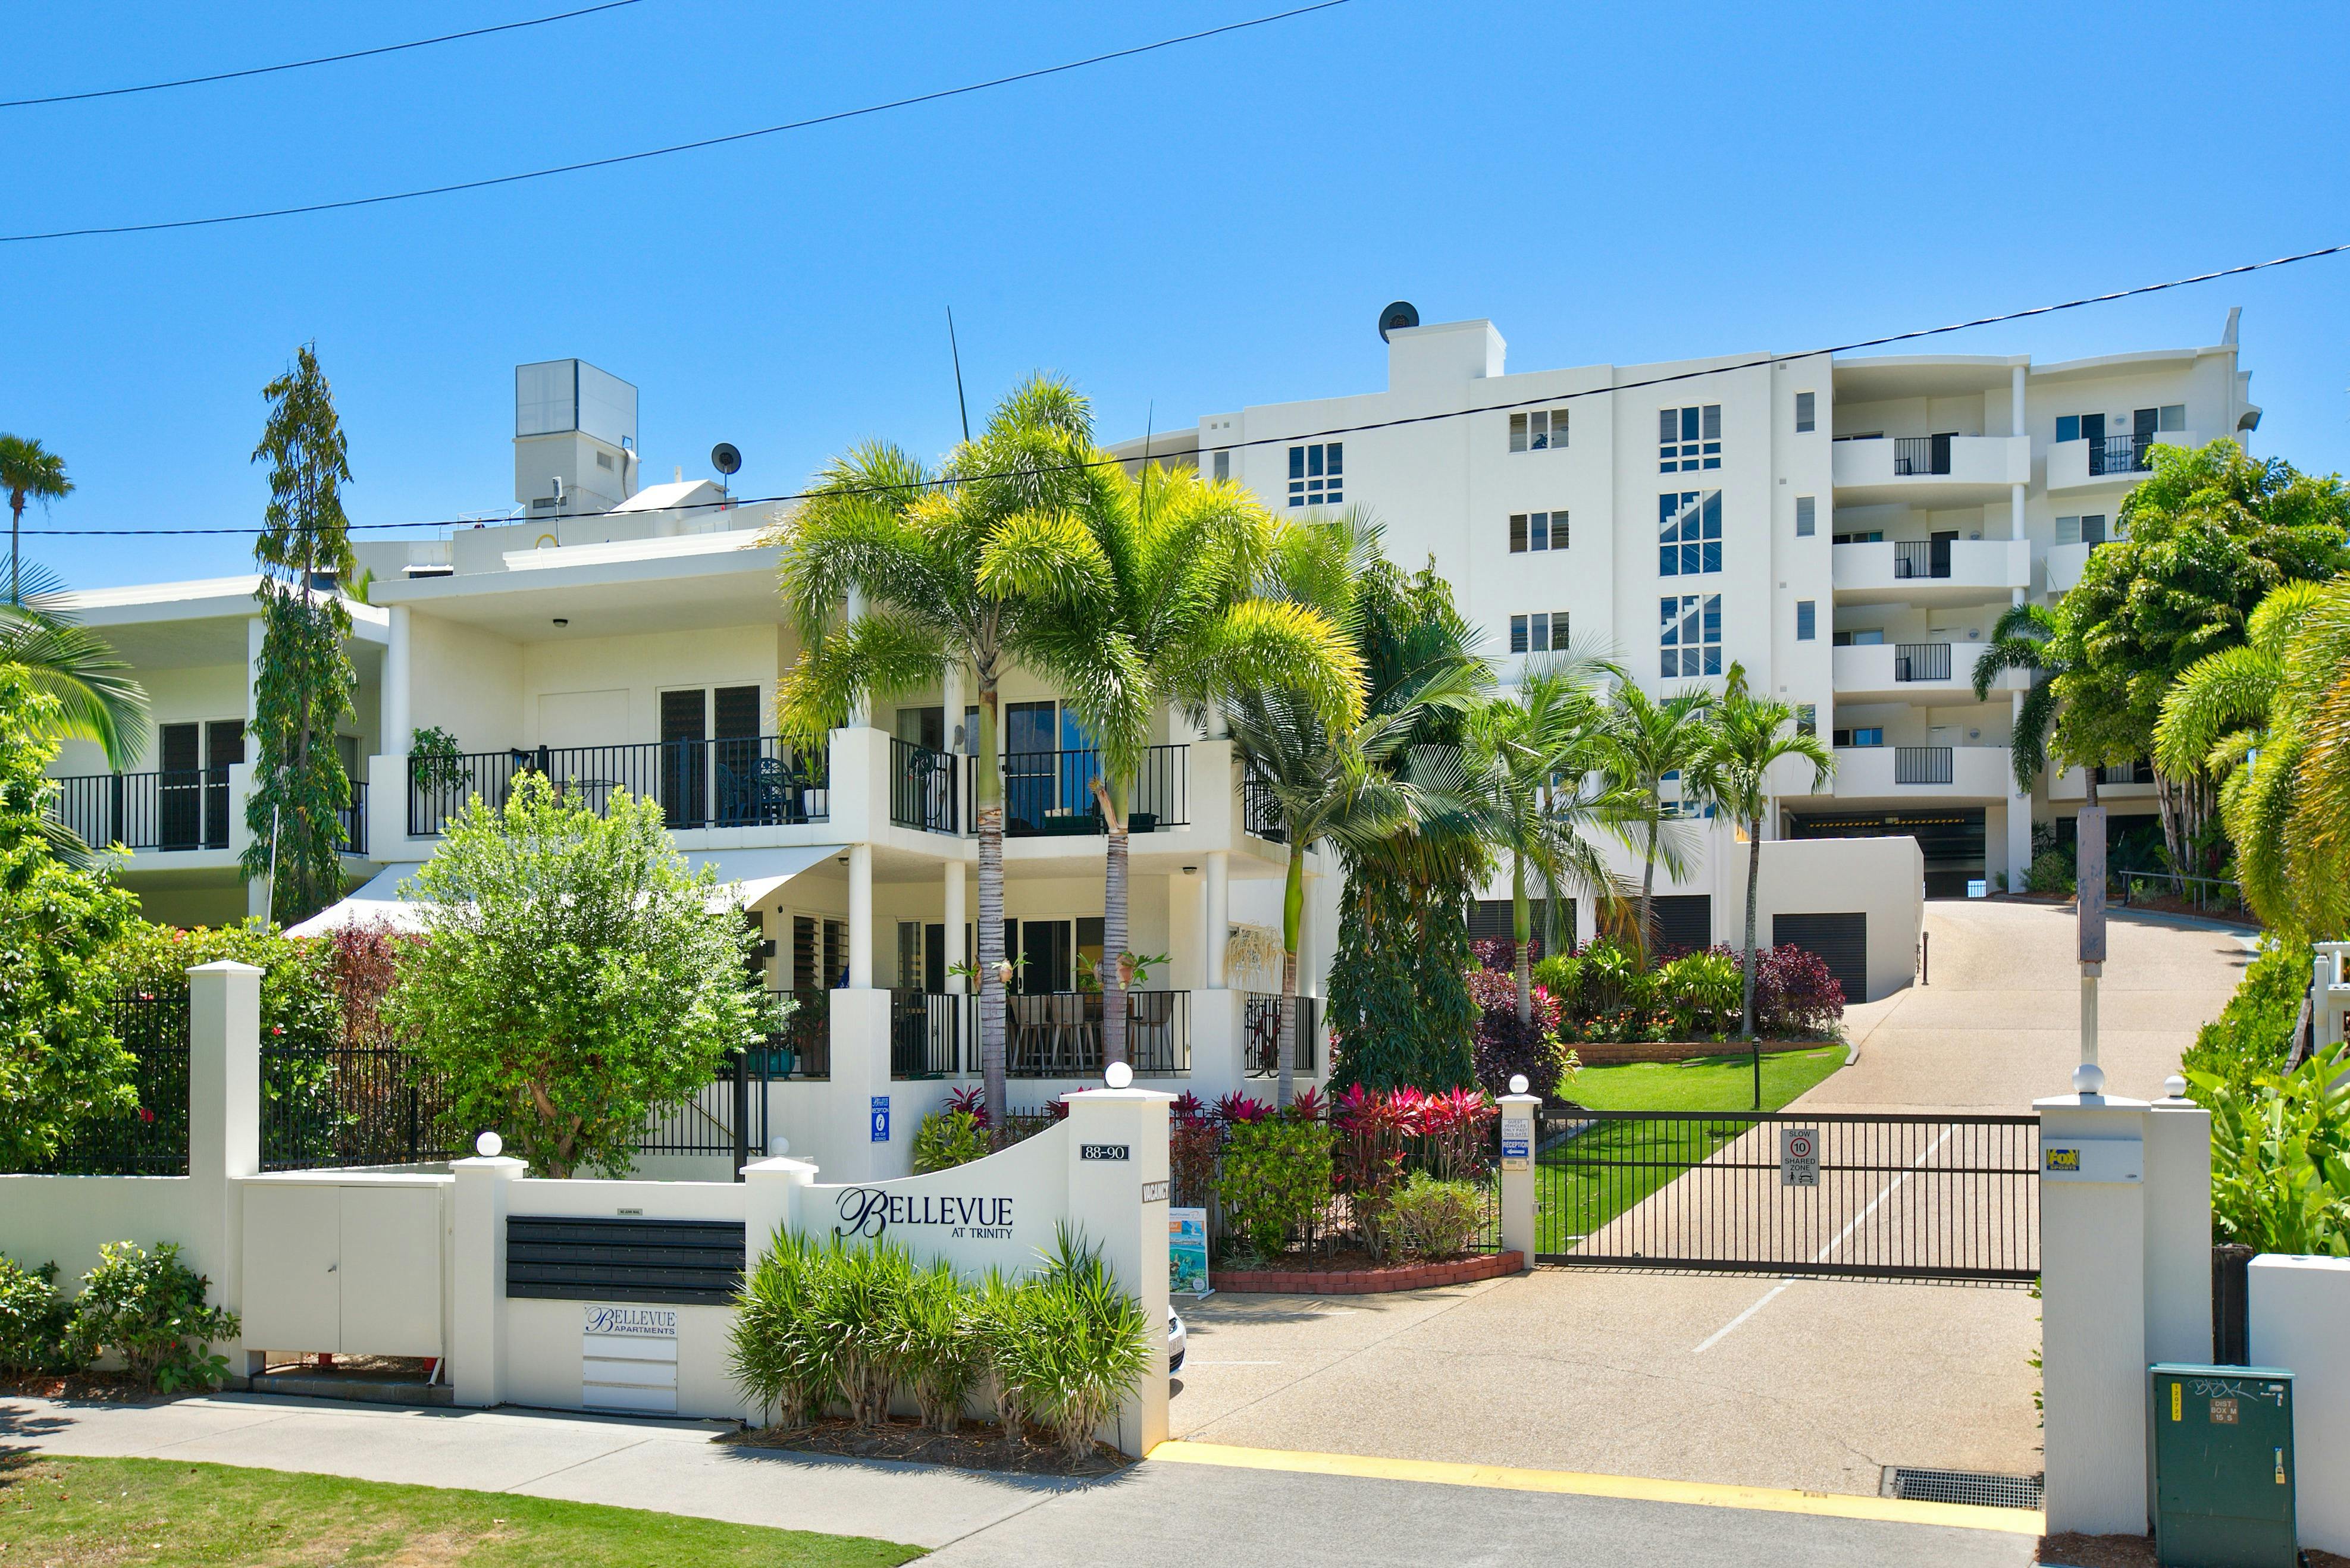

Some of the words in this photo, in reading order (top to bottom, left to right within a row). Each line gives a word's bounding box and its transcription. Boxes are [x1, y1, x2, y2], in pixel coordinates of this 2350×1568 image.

[1085, 1146, 1124, 1159] 88-90
[1794, 1143, 1806, 1152] 10
[2049, 1149, 2076, 1165] FOX
[1143, 1182, 1169, 1202] VACANCY
[835, 1187, 1013, 1238] BELLEVUE
[952, 1228, 965, 1237] AT
[970, 1228, 1013, 1238] TRINITY
[586, 1306, 675, 1332] BELLEVUE
[615, 1326, 675, 1334] APARTMENTS
